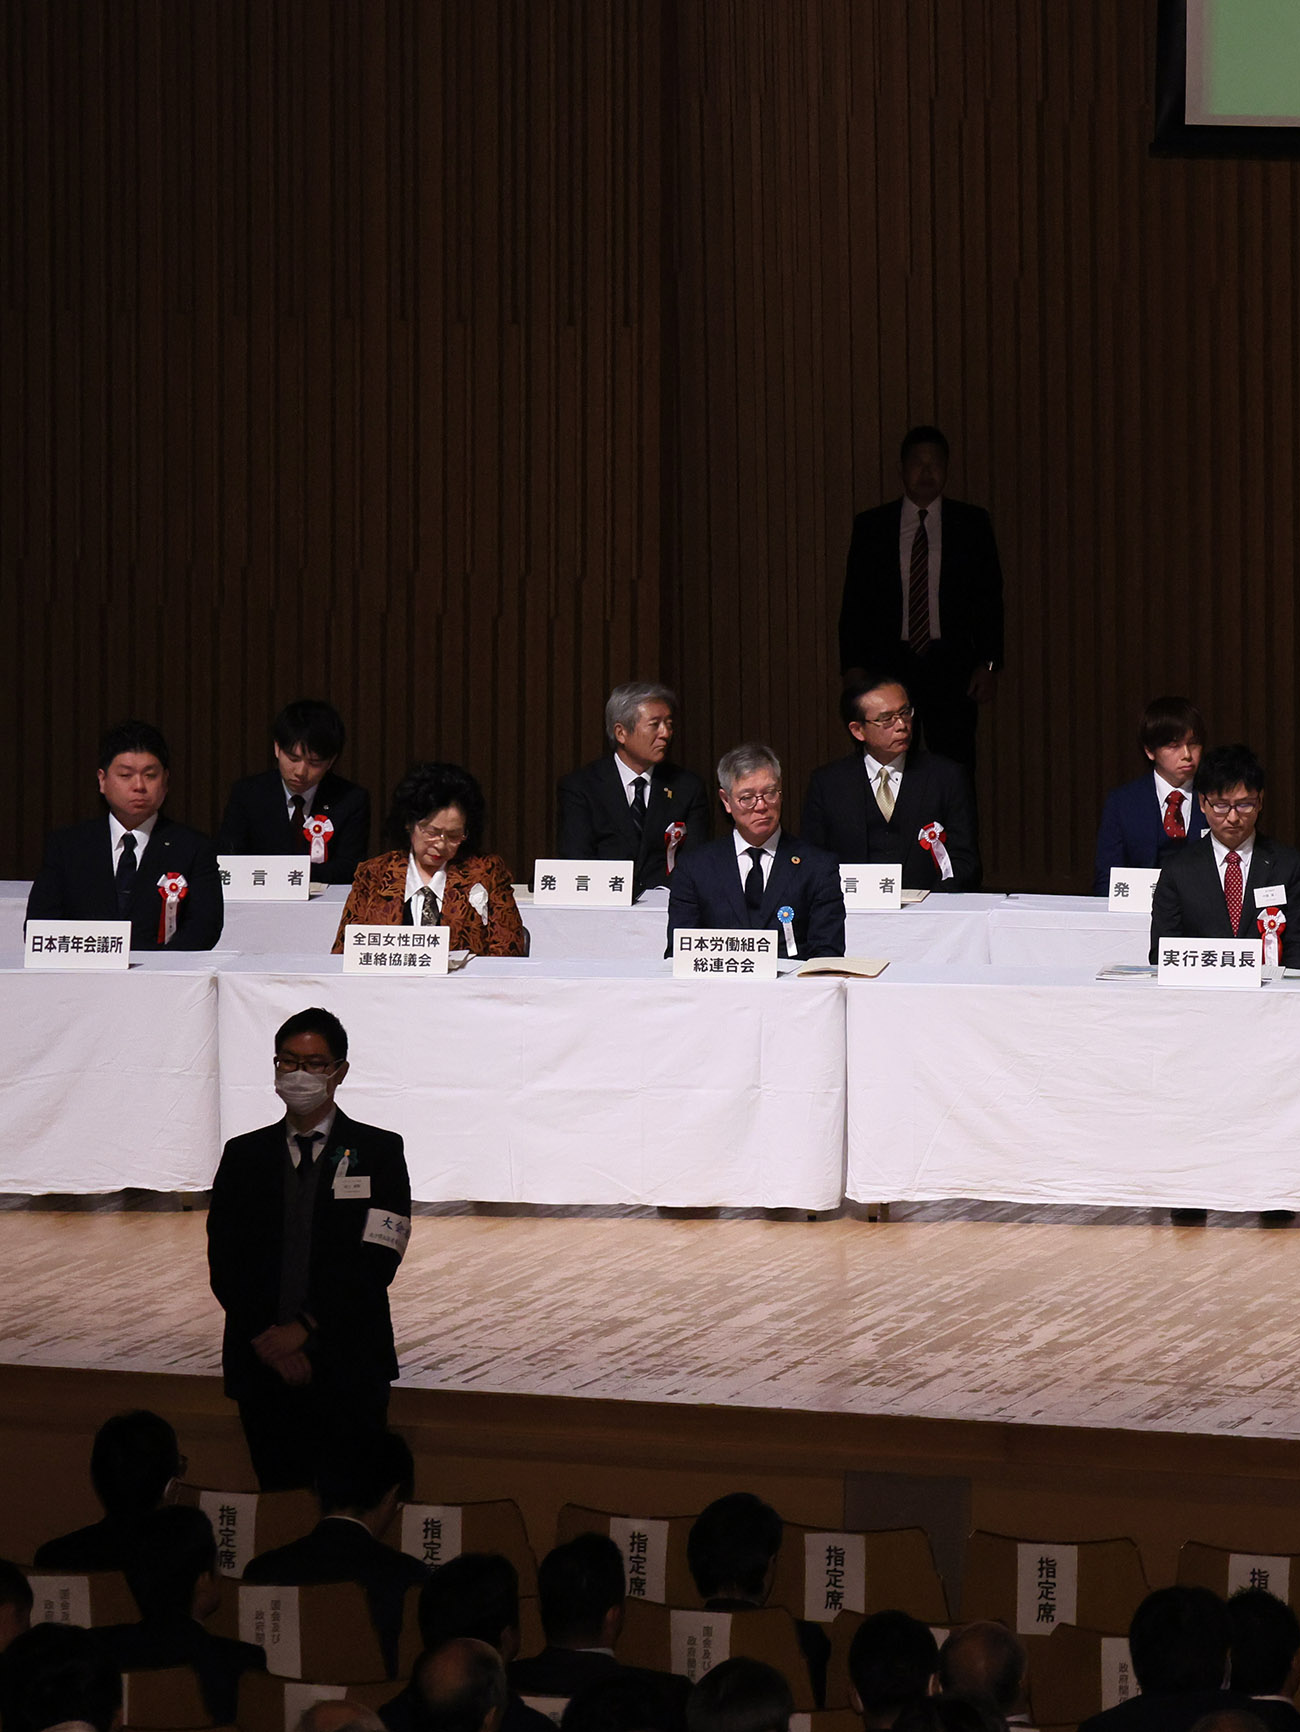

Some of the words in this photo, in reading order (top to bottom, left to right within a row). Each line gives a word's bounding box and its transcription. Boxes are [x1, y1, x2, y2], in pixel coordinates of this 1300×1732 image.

[220, 870, 303, 886] 発言者
[541, 875, 625, 892] 発言者
[32, 935, 123, 954] 日本青年会議所
[353, 932, 441, 948] 全国女性団体
[680, 936, 771, 953] 日本労働組合
[358, 952, 432, 967] 連絡協議会
[694, 957, 755, 974] 総連合会
[1163, 949, 1256, 968] 実行委員長
[218, 1505, 238, 1570] 指定席
[628, 1531, 648, 1596] 指定席
[824, 1545, 846, 1611] 指定席
[1036, 1556, 1058, 1624] 指定席
